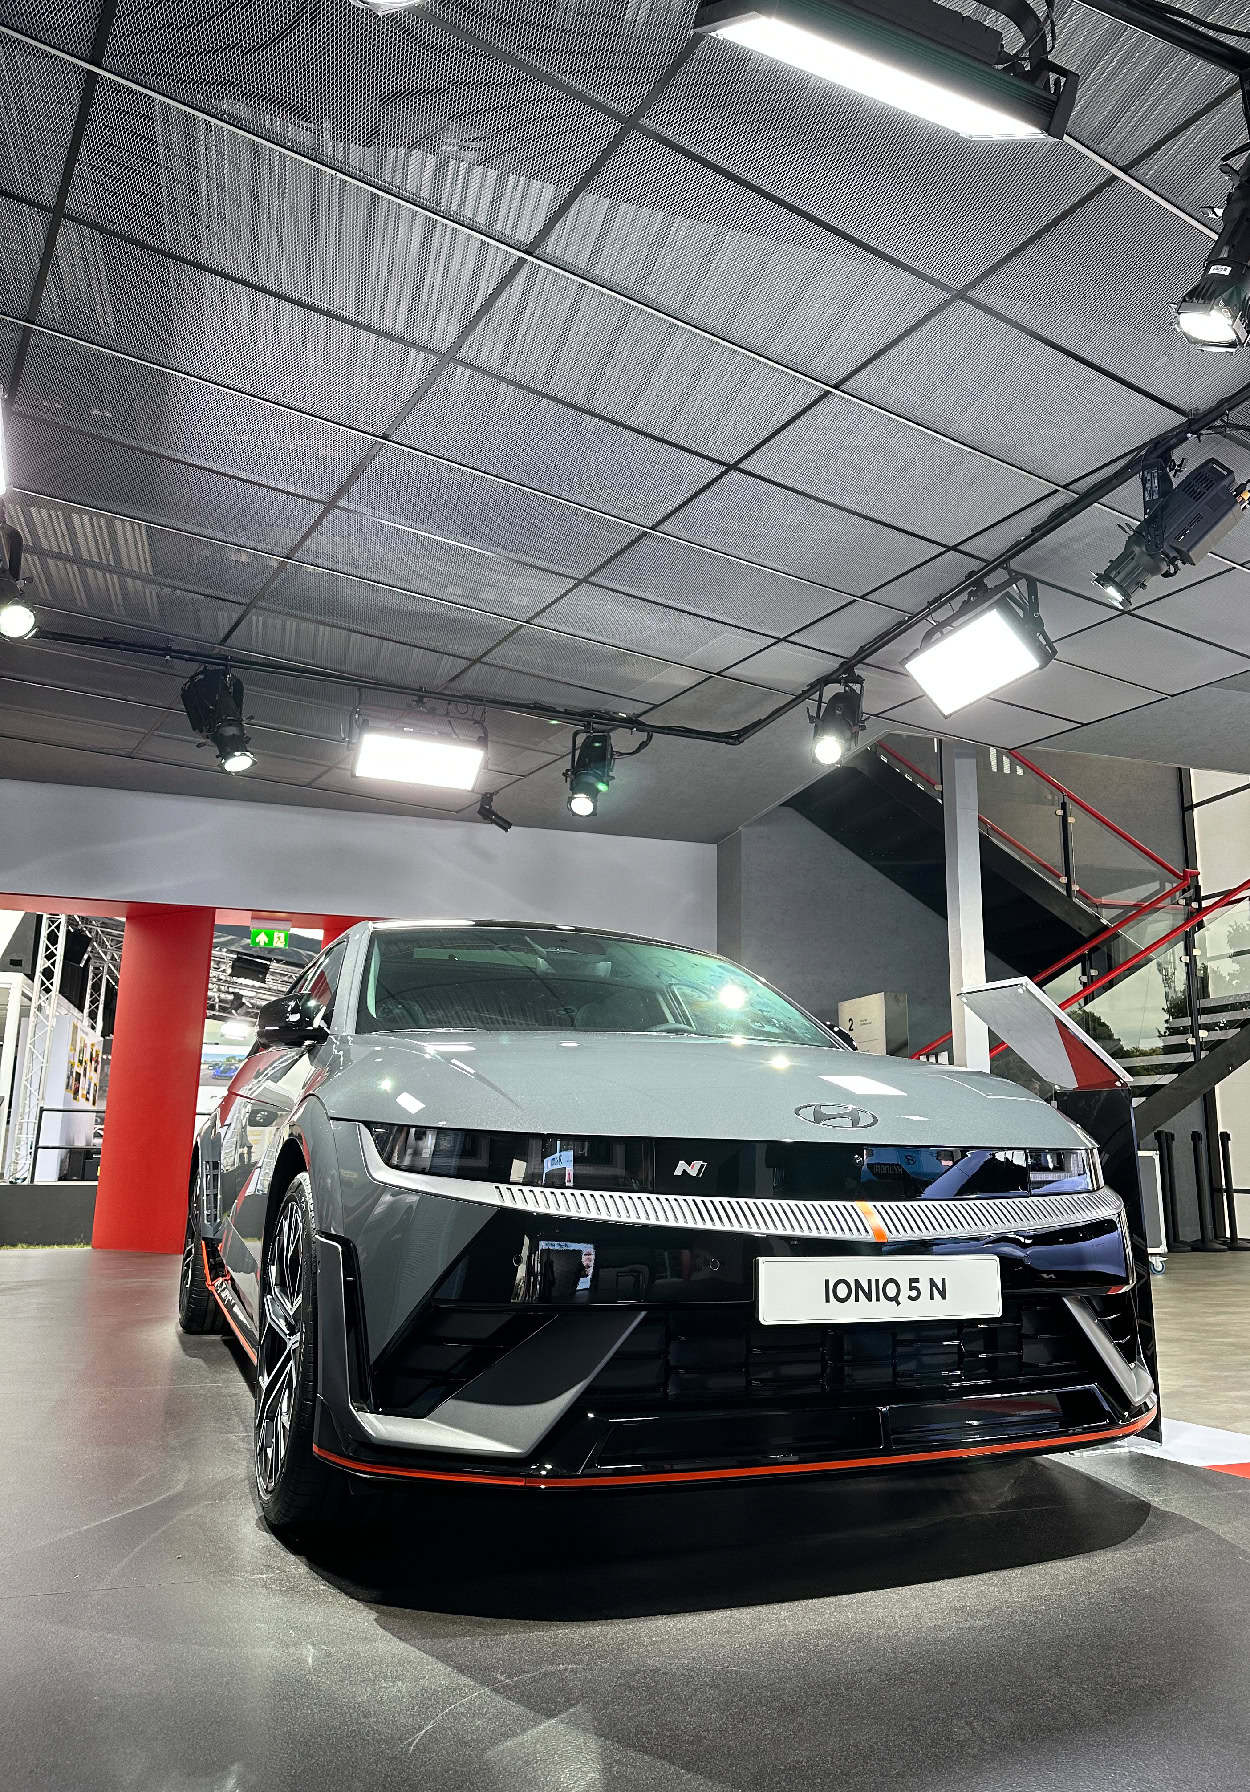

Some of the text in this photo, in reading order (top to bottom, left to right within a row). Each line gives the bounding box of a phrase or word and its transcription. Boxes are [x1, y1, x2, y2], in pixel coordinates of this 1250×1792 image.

[848, 1017, 854, 1032] 2
[824, 1277, 947, 1307] IONIQ 5 N
